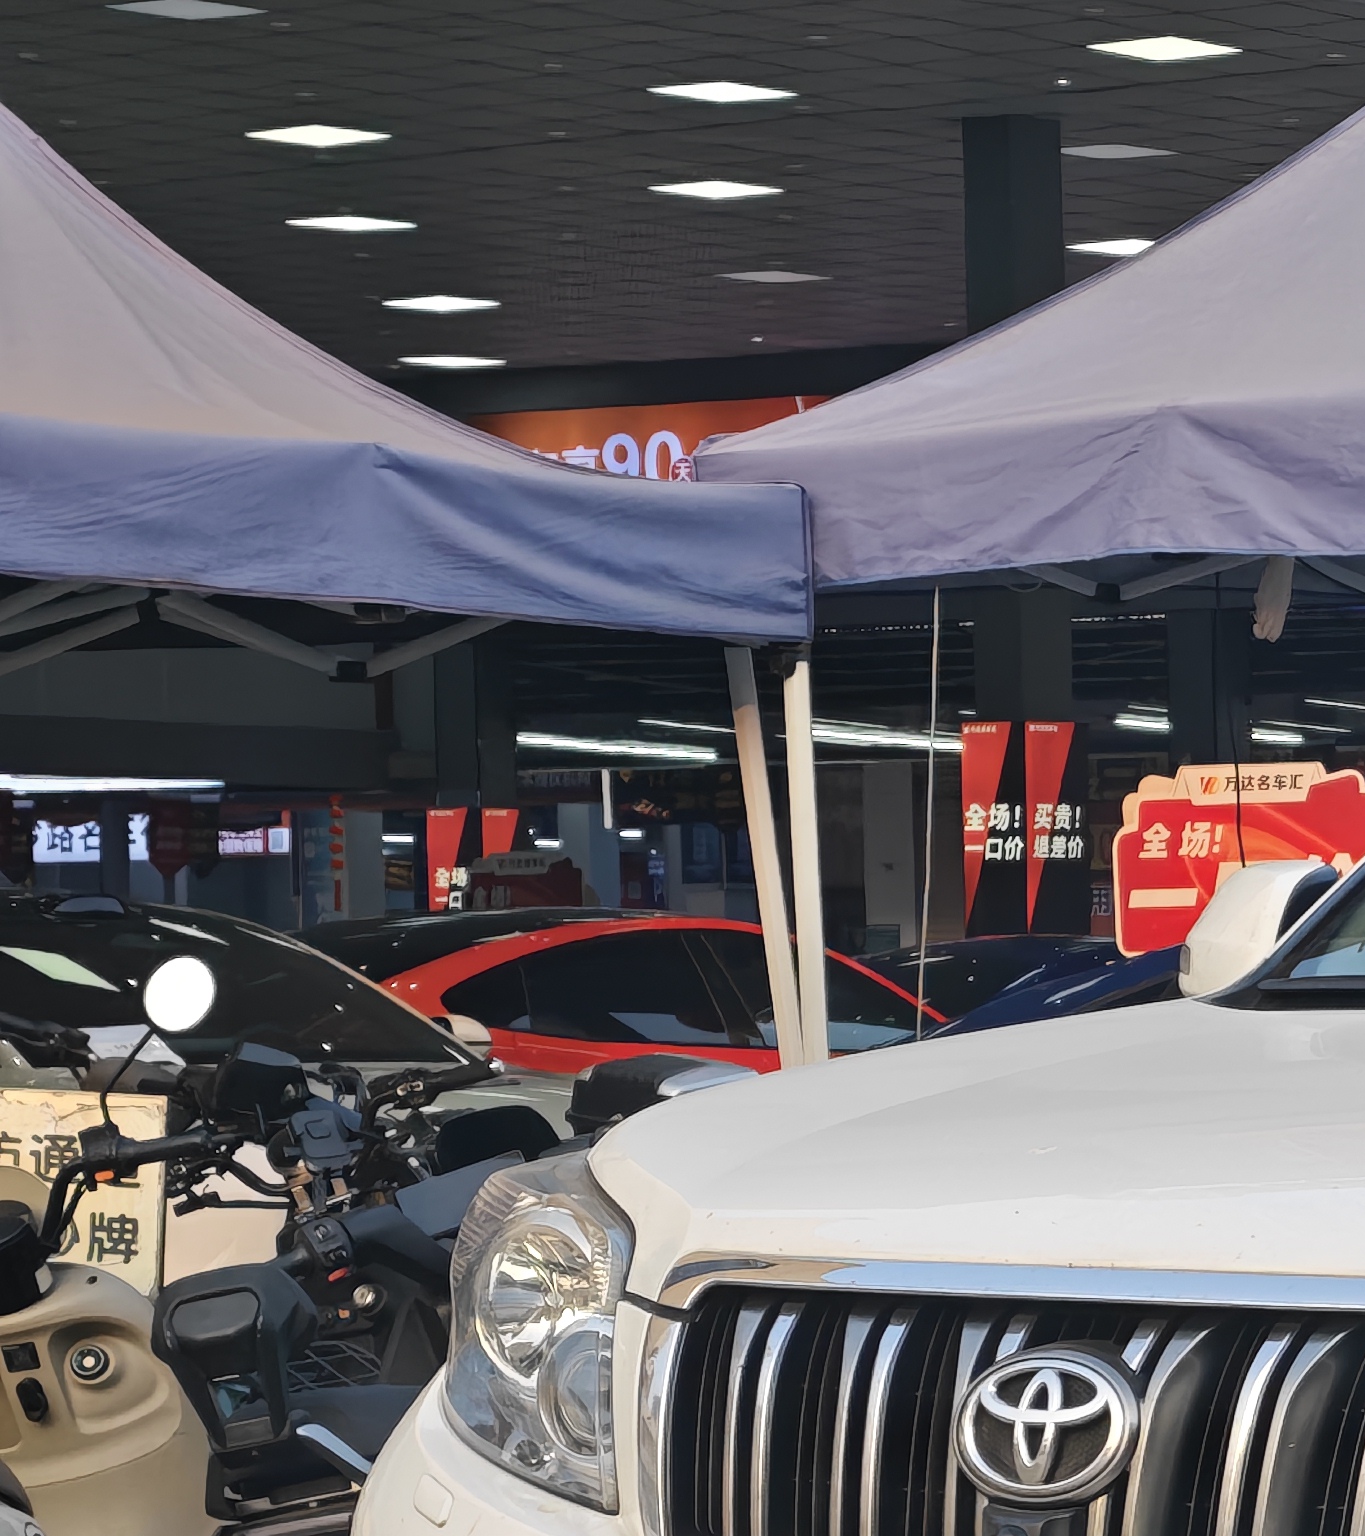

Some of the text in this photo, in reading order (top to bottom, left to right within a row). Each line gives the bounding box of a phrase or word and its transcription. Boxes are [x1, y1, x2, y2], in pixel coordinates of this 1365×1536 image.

[1223, 774, 1304, 793] 万达名车汇
[964, 836, 1025, 861] 一口价
